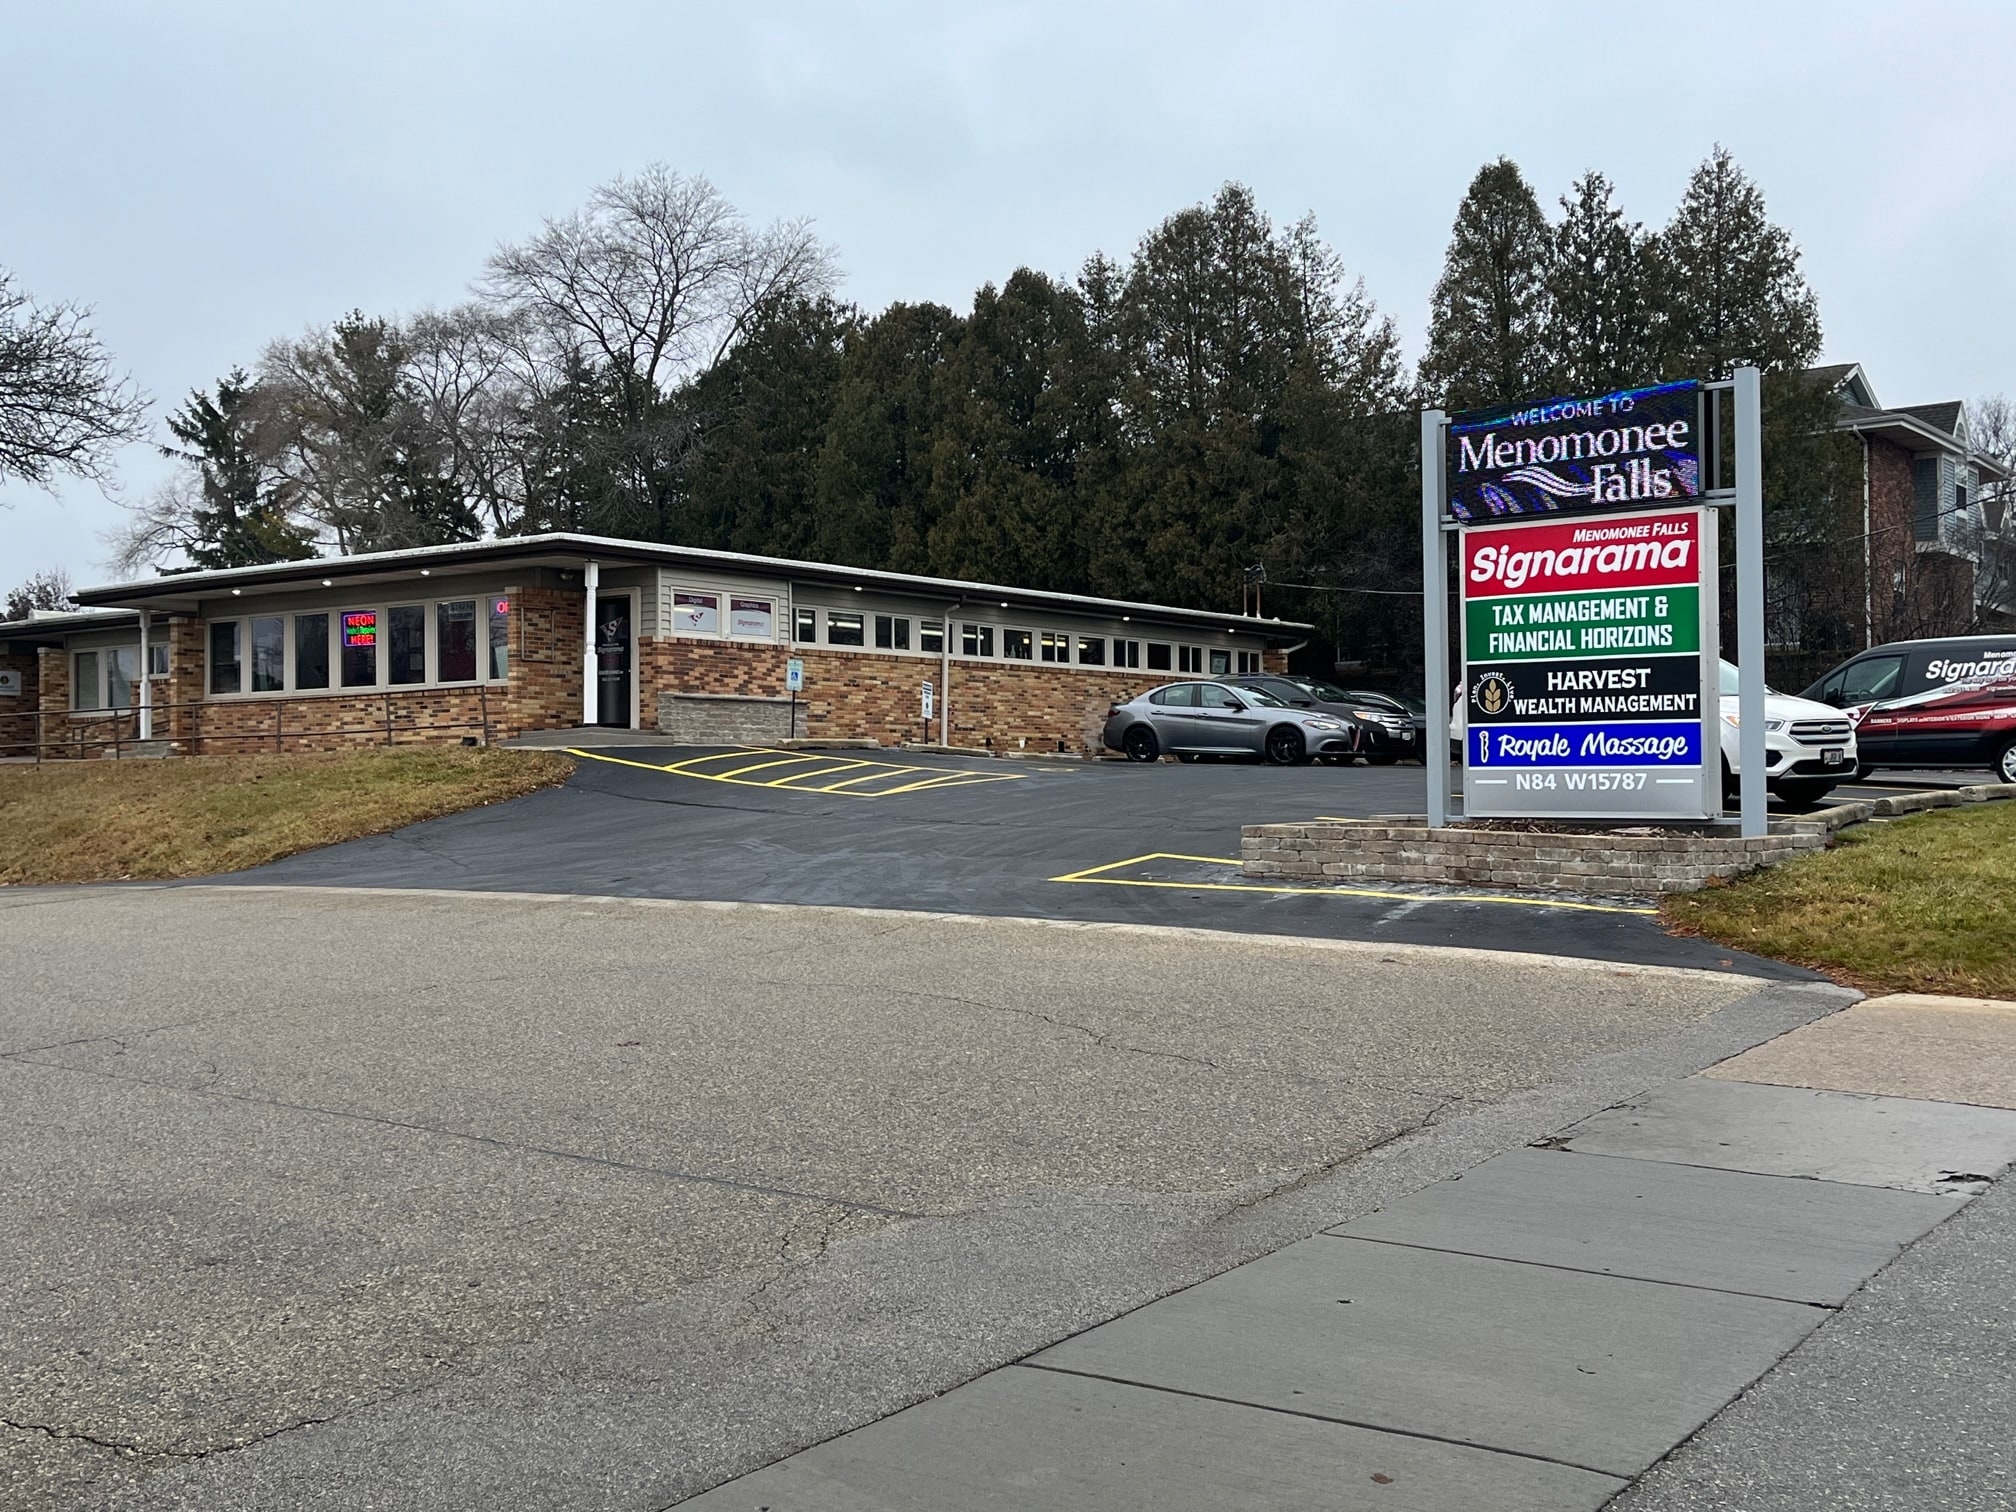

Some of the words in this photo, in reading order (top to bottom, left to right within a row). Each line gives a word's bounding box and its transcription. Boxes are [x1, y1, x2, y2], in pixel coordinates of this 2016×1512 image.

[1511, 399, 1603, 427] WELCOME
[1609, 397, 1635, 413] TO
[1458, 419, 1688, 473] Menomonee
[1590, 457, 1673, 504] Falls
[1573, 525, 1650, 543] MENOMONEE
[1652, 522, 1689, 537] FALLS
[1470, 539, 1691, 588] Signarama
[348, 615, 374, 626] NEON
[1492, 604, 1525, 626] TAX
[1529, 597, 1650, 625] MANAGEMENT
[1654, 596, 1669, 618] &
[1489, 629, 1576, 653] FINANCIAL
[1581, 624, 1673, 649] HORIZONS
[1547, 668, 1651, 692] HARVEST
[1925, 659, 2016, 683] Signara
[1513, 698, 1576, 715] WEALTH
[1580, 694, 1697, 714] MANAGEMENT
[1497, 732, 1571, 761] Royale
[1580, 731, 1689, 760] Massage
[1516, 774, 1557, 790] N84
[1564, 773, 1648, 790] W15787
